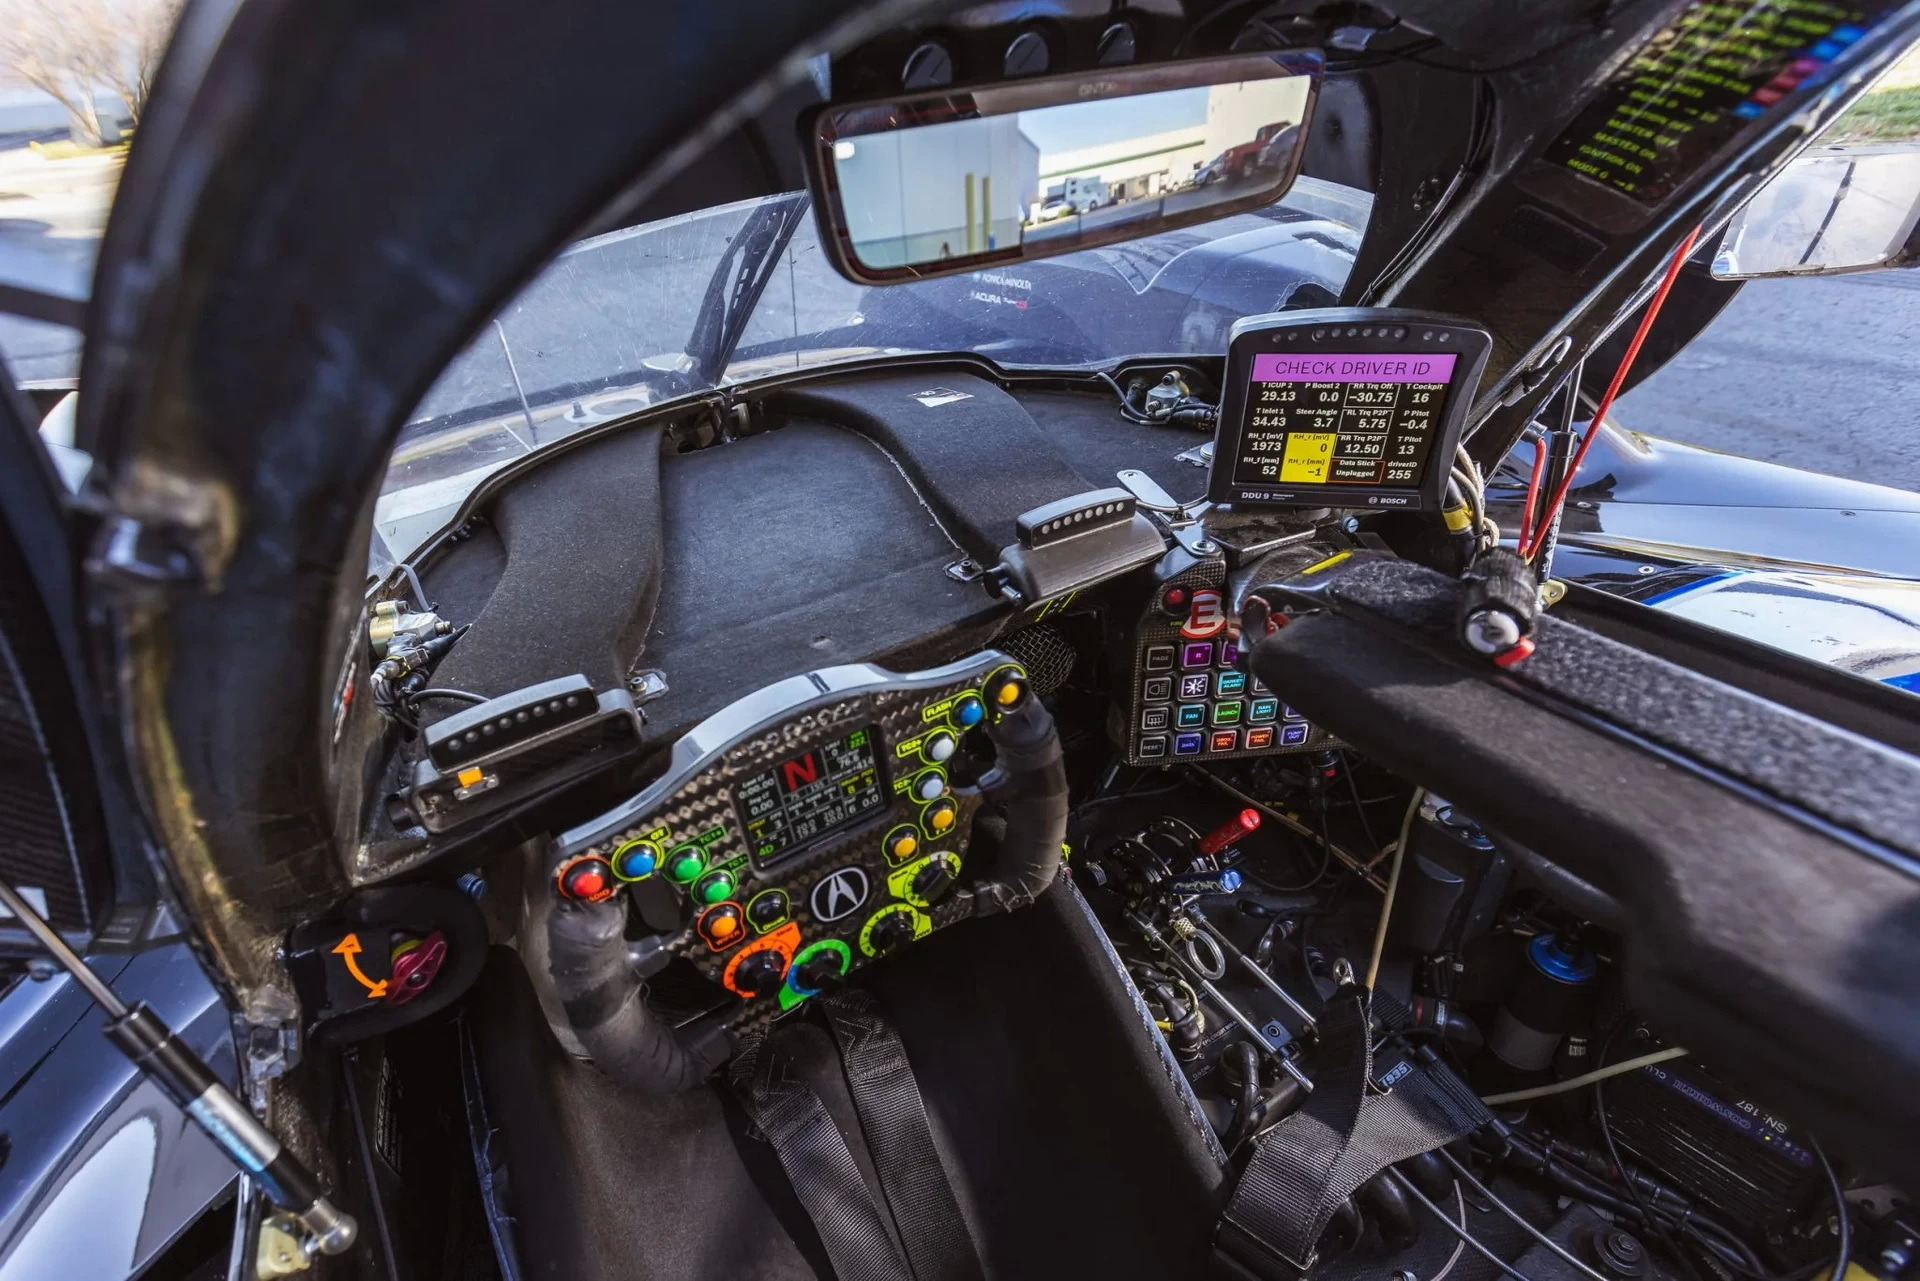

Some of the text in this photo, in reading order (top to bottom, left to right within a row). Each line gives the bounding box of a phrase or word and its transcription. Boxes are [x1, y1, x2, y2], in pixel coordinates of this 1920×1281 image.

[1593, 132, 1657, 160] MASTER ON
[1579, 145, 1642, 174] IGNITION ON
[1567, 158, 1600, 174] MODE
[975, 292, 1001, 305] ACURA
[1275, 361, 1431, 376] CHECK DRIVER ID
[1261, 391, 1296, 401] 29.13
[1319, 391, 1339, 402] 0.0
[1412, 392, 1430, 403] 16
[1316, 408, 1338, 416] Angle
[1252, 416, 1286, 426] 34.43
[1313, 417, 1334, 427] 3.7
[1358, 418, 1386, 428] 5.75
[1248, 432, 1266, 440] RH_f
[1251, 441, 1281, 451] 1973
[1320, 443, 1327, 453] 0
[1344, 443, 1379, 454] 12.50
[1398, 445, 1415, 455] 13
[1387, 460, 1417, 468] driverID
[1262, 466, 1277, 475] 52
[1308, 468, 1321, 476] -1
[1336, 469, 1375, 478] Unplugged
[1387, 470, 1412, 479] 255
[1263, 492, 1270, 500] 9
[1380, 497, 1407, 505] BOSCH
[1190, 599, 1217, 630] E
[926, 700, 952, 717] FLASH
[784, 752, 817, 793] N
[862, 794, 879, 808] 0.0
[751, 799, 774, 816] 0.00
[849, 805, 856, 814] 6
[1382, 1063, 1408, 1087] 1935
[1672, 1080, 1751, 1130] COSWORTH
[1736, 1100, 1787, 1134] SN: 187
